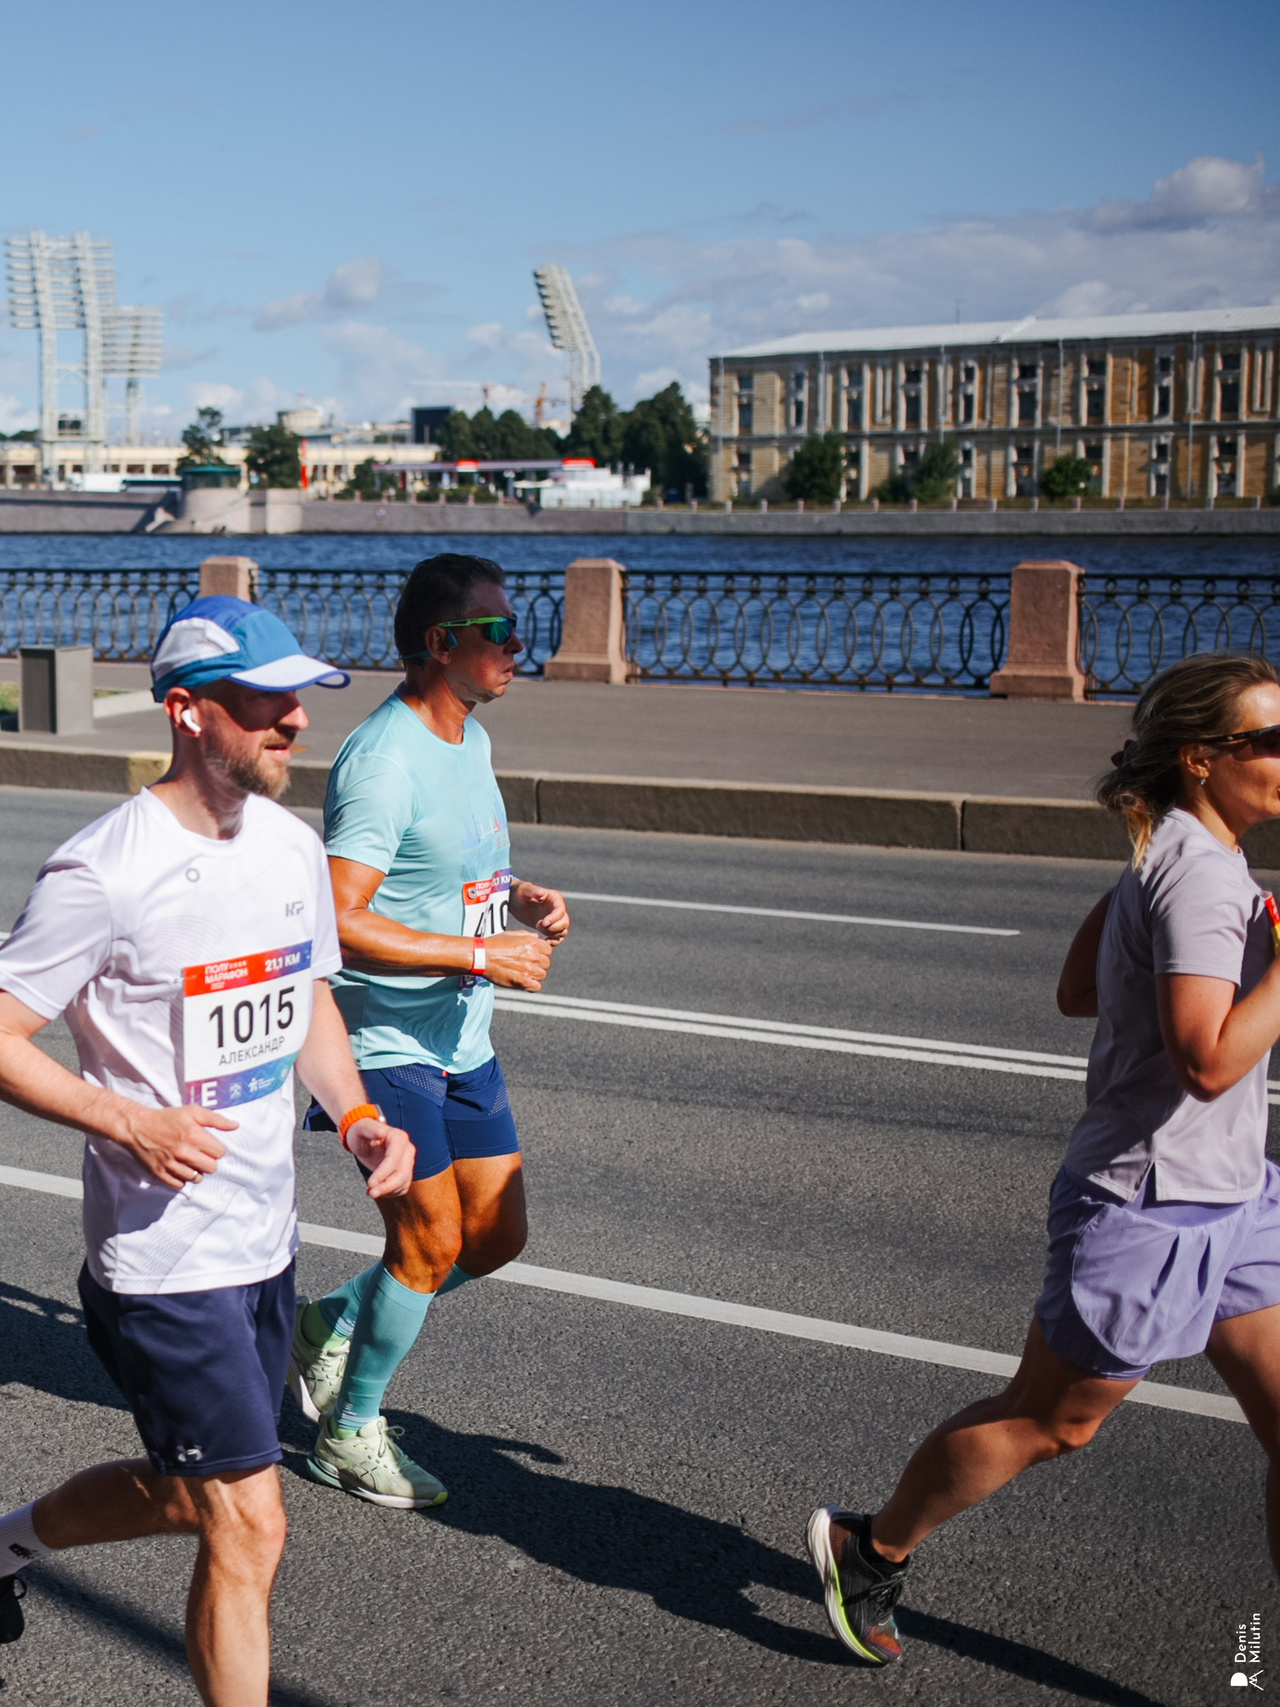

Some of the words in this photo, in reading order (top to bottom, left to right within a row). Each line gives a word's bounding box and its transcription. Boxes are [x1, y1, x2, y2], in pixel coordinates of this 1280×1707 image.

[204, 962, 229, 975] ПОЛУ
[264, 957, 284, 973] 21,1
[284, 952, 301, 967] КМ
[204, 967, 249, 984] МАРАФОН
[209, 986, 295, 1048] 1015
[218, 1035, 286, 1066] АЛЕКСАНДР
